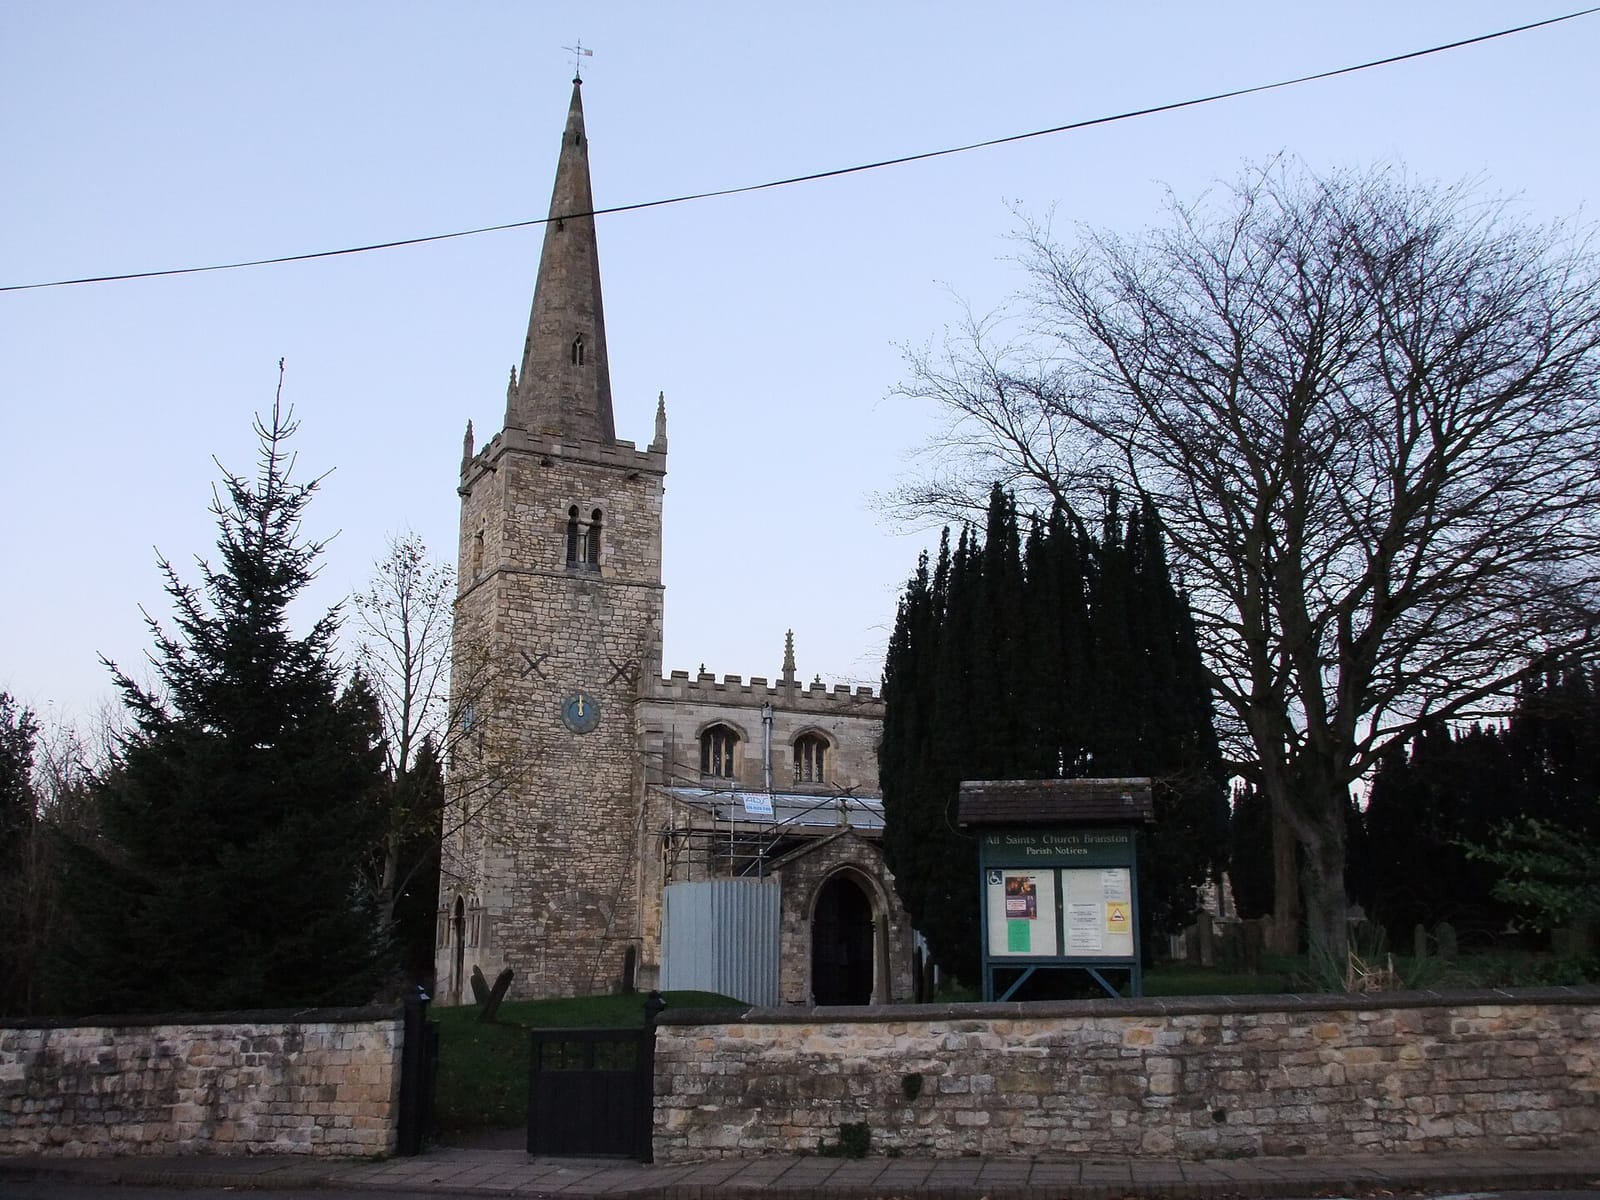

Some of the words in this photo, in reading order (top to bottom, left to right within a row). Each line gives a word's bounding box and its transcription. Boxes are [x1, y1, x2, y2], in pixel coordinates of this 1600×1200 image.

[987, 835, 1000, 845] All
[1005, 835, 1036, 845] Saints
[1042, 834, 1080, 845] Church
[1084, 834, 1129, 844] Branston
[1026, 846, 1053, 855] Parish
[1055, 846, 1088, 855] Notices
